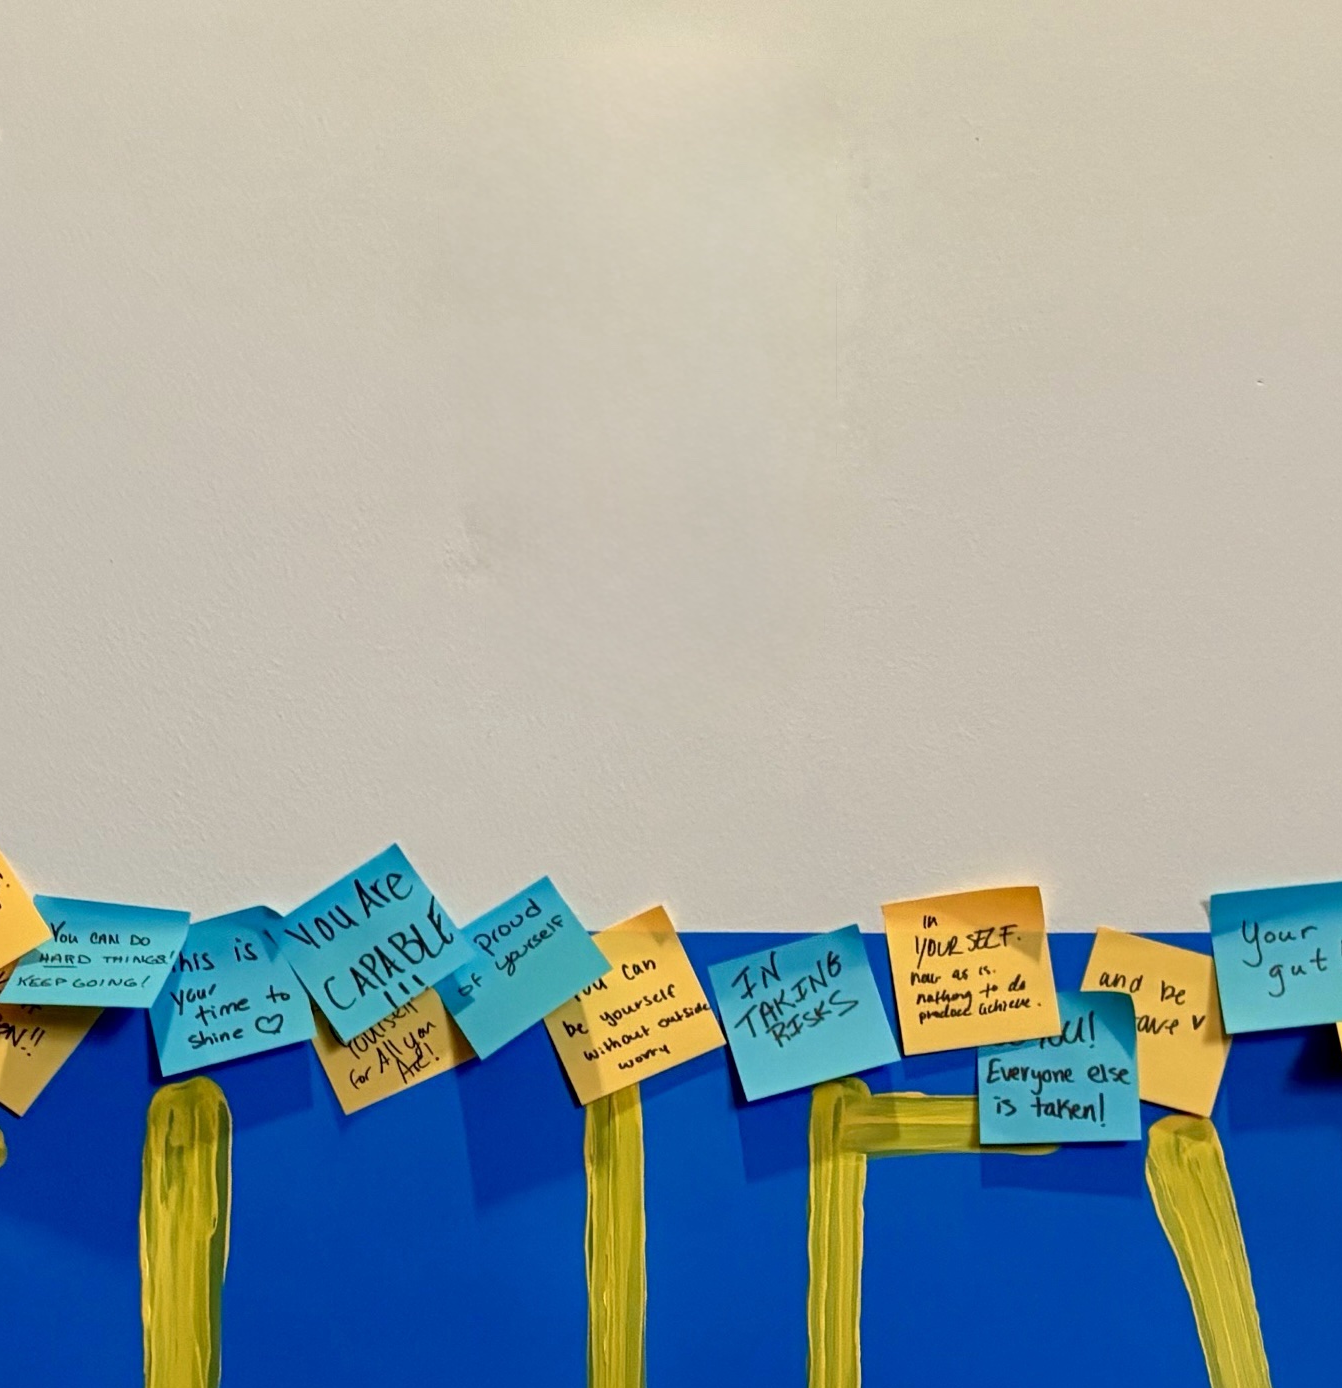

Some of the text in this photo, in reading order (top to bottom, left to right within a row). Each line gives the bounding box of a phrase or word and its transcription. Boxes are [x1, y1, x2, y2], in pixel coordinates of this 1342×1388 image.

[39, 949, 176, 966] HARD THINGS!
[90, 933, 120, 946] CAN
[322, 895, 454, 1012] CAPABLE
[494, 914, 565, 976] yourself
[1241, 919, 1318, 966] Your
[16, 976, 67, 989] KEEP
[72, 974, 150, 989] GOING!
[731, 950, 781, 999] IN
[1099, 971, 1143, 993] and
[195, 998, 250, 1027] time
[598, 983, 676, 1028] yourself
[734, 951, 843, 1039] TAKING
[770, 990, 858, 1048] RISKS
[187, 1027, 244, 1050] shine
[583, 1026, 650, 1062] without
[618, 1044, 671, 1072] worry
[986, 1058, 1130, 1096] Everyone else
[1035, 1098, 1106, 1128] taken!
